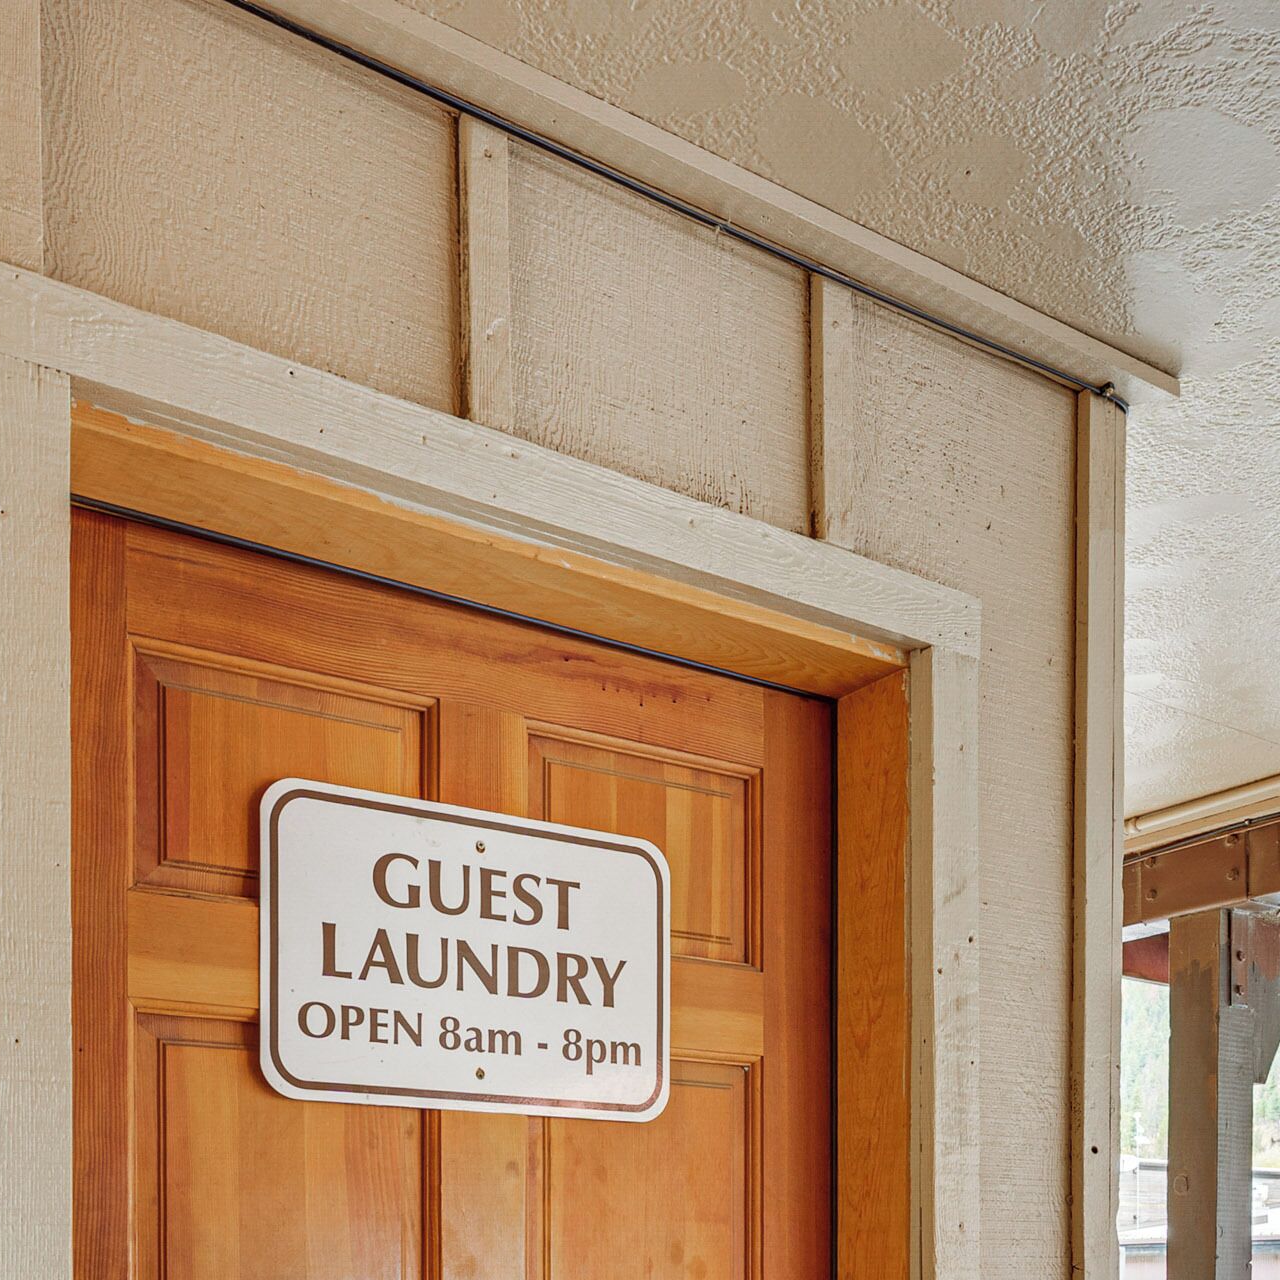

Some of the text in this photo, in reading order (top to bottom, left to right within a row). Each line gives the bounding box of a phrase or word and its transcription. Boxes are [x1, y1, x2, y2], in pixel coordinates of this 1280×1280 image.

[372, 852, 581, 931] GUEST
[321, 921, 628, 1009] LAUNDRY
[297, 1001, 423, 1047] OPEN
[438, 1015, 522, 1056] 8am
[561, 1028, 642, 1075] 8pm
